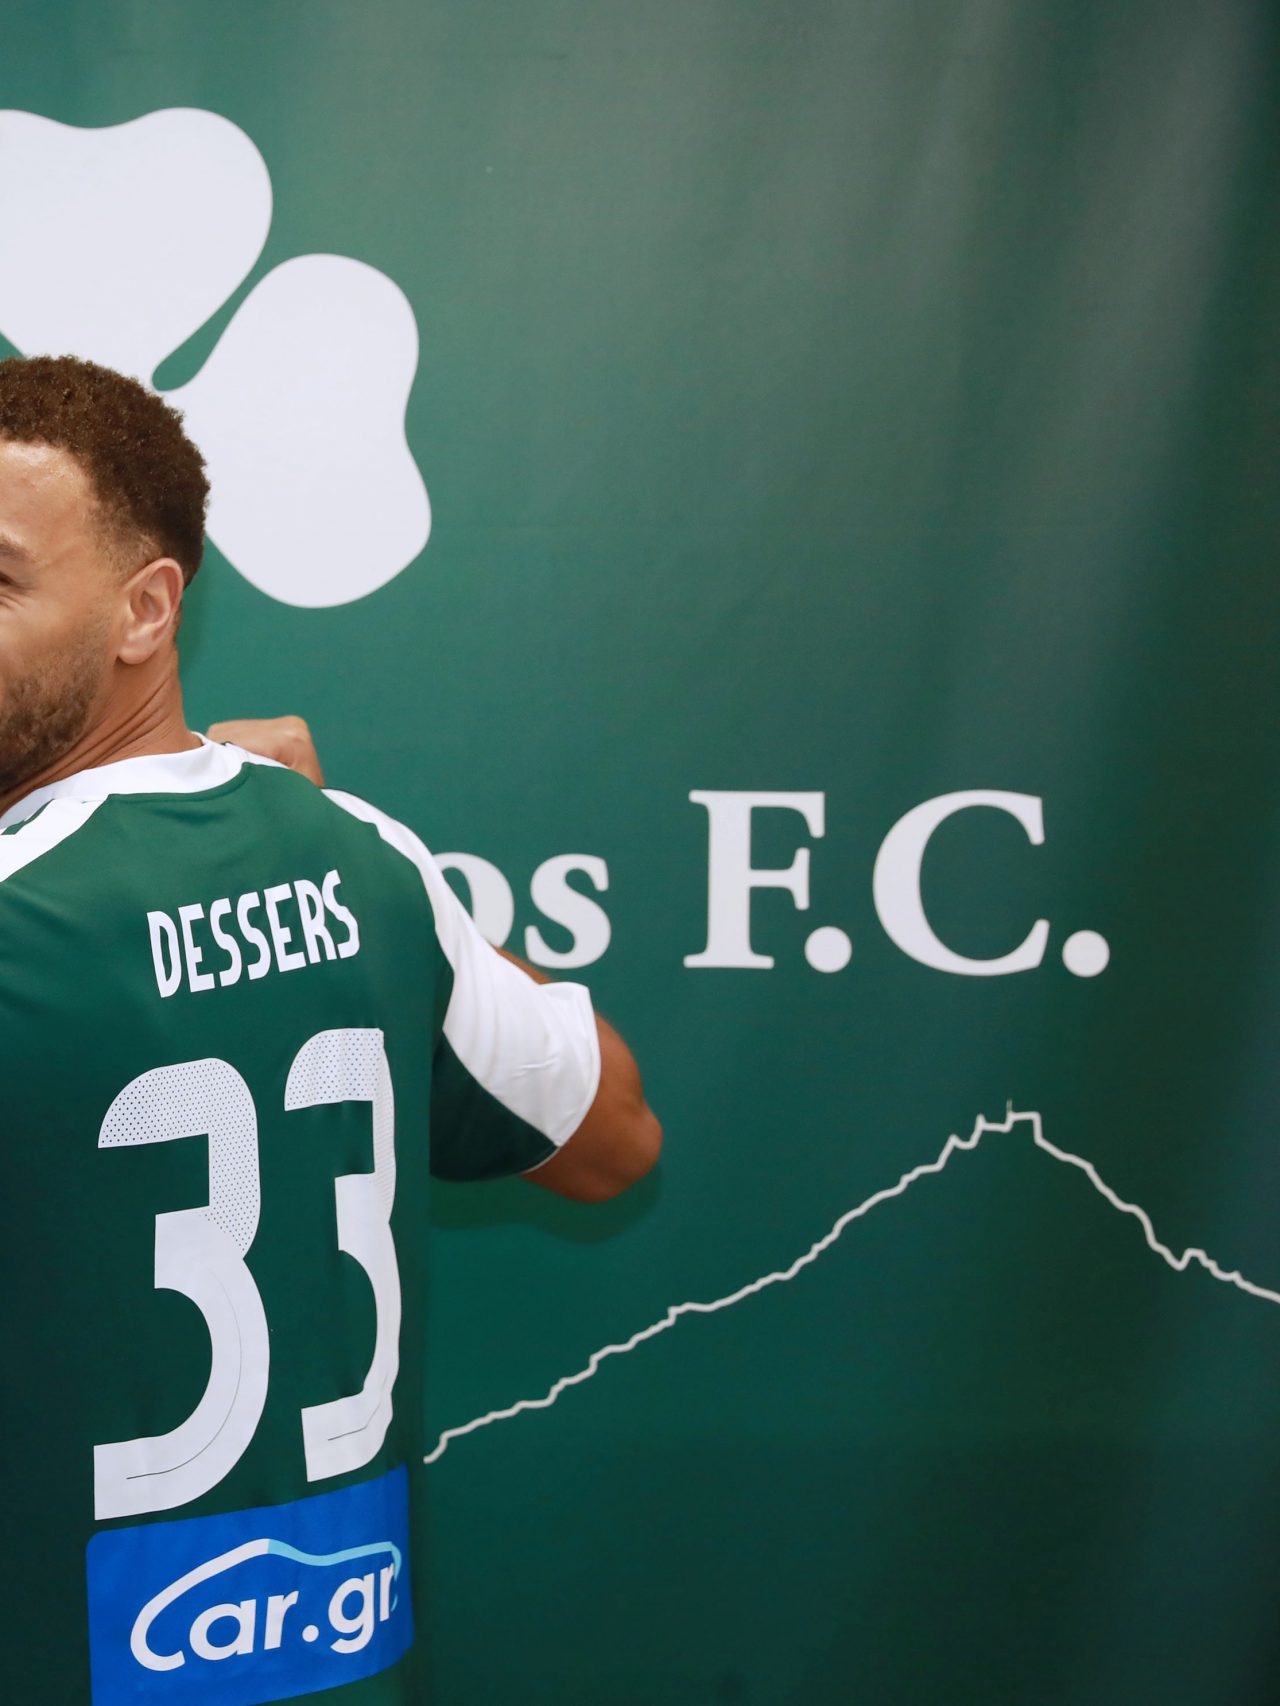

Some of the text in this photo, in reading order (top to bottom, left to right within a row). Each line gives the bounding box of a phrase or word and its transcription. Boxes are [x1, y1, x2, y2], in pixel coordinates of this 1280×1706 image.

[147, 869, 360, 998] DESSERS
[683, 789, 1111, 977] F.C.
[93, 1027, 402, 1521] 33
